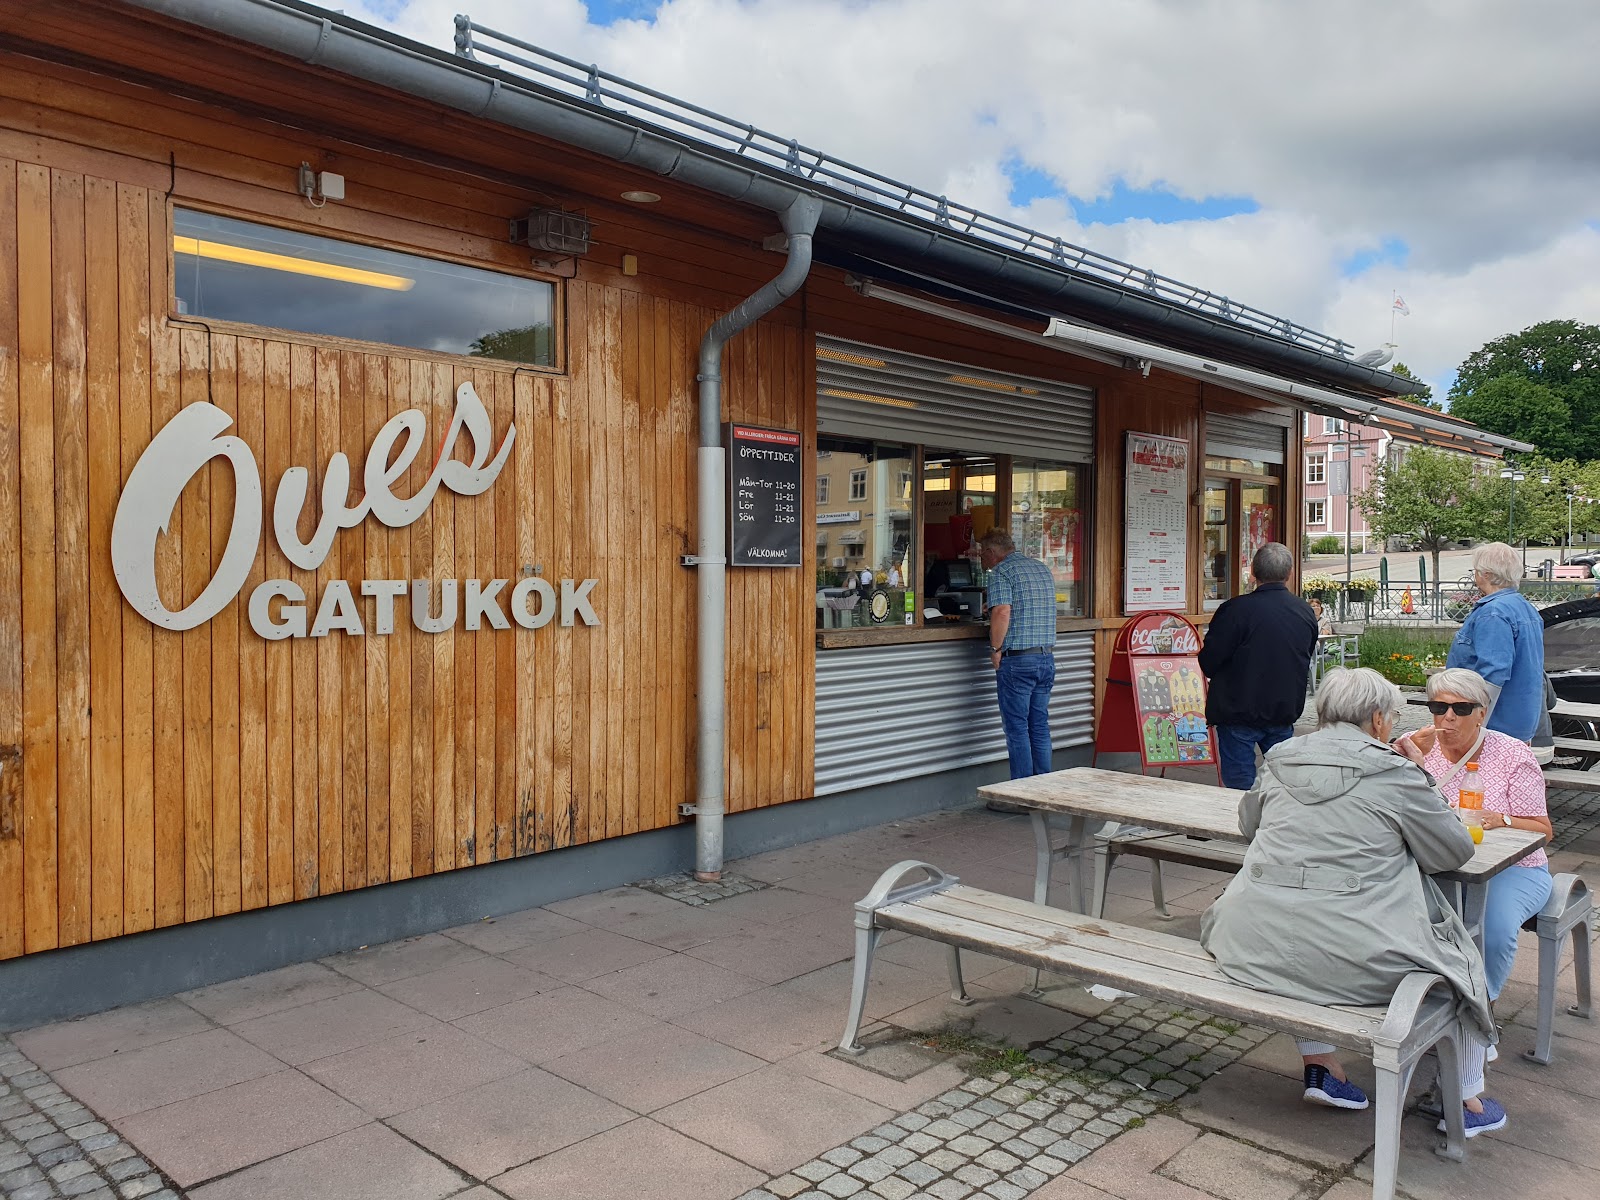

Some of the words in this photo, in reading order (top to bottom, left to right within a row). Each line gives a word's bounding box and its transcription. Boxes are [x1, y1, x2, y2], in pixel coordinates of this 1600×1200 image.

[740, 445, 795, 464] ÖPPETTIDER
[775, 481, 796, 490] 11-20
[738, 489, 754, 499] Fre
[775, 492, 795, 501] 11-21
[111, 381, 516, 631] Oves
[738, 500, 754, 510] Lör
[775, 503, 795, 512] 11-21
[738, 512, 755, 522] Sön
[774, 515, 796, 524] 11-20
[248, 564, 600, 640] GATUKÖK
